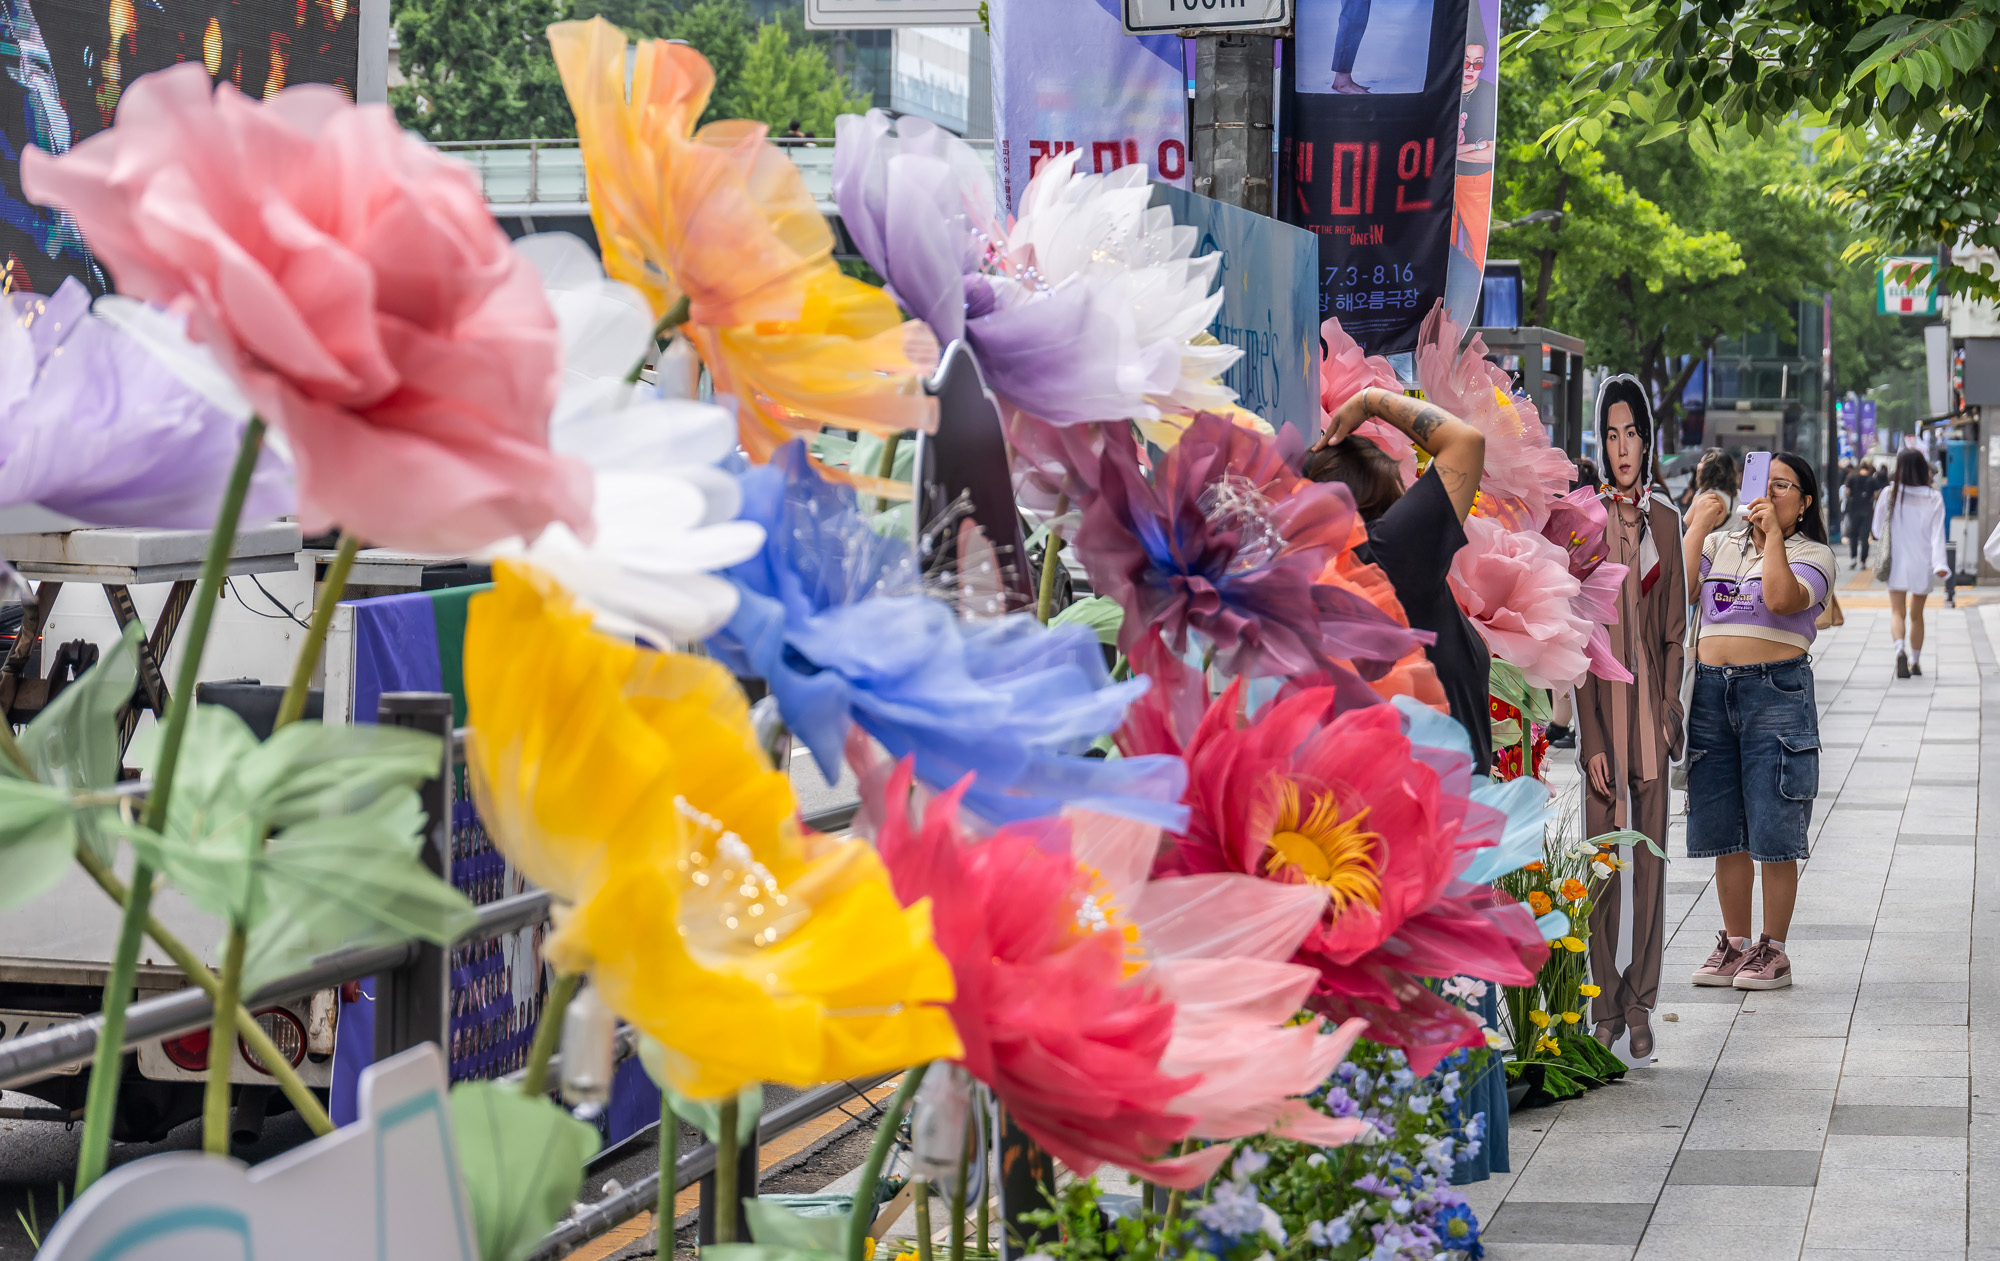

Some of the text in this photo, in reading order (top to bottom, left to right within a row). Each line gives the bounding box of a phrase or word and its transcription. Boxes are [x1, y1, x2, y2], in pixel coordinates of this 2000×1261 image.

[1321, 225, 1333, 234] THE
[1334, 225, 1356, 235] RIGHT
[1350, 232, 1369, 246] ONE
[1369, 224, 1384, 244] IN
[1335, 288, 1420, 312] 해오름극장
[1888, 287, 1925, 296] ELEEN
